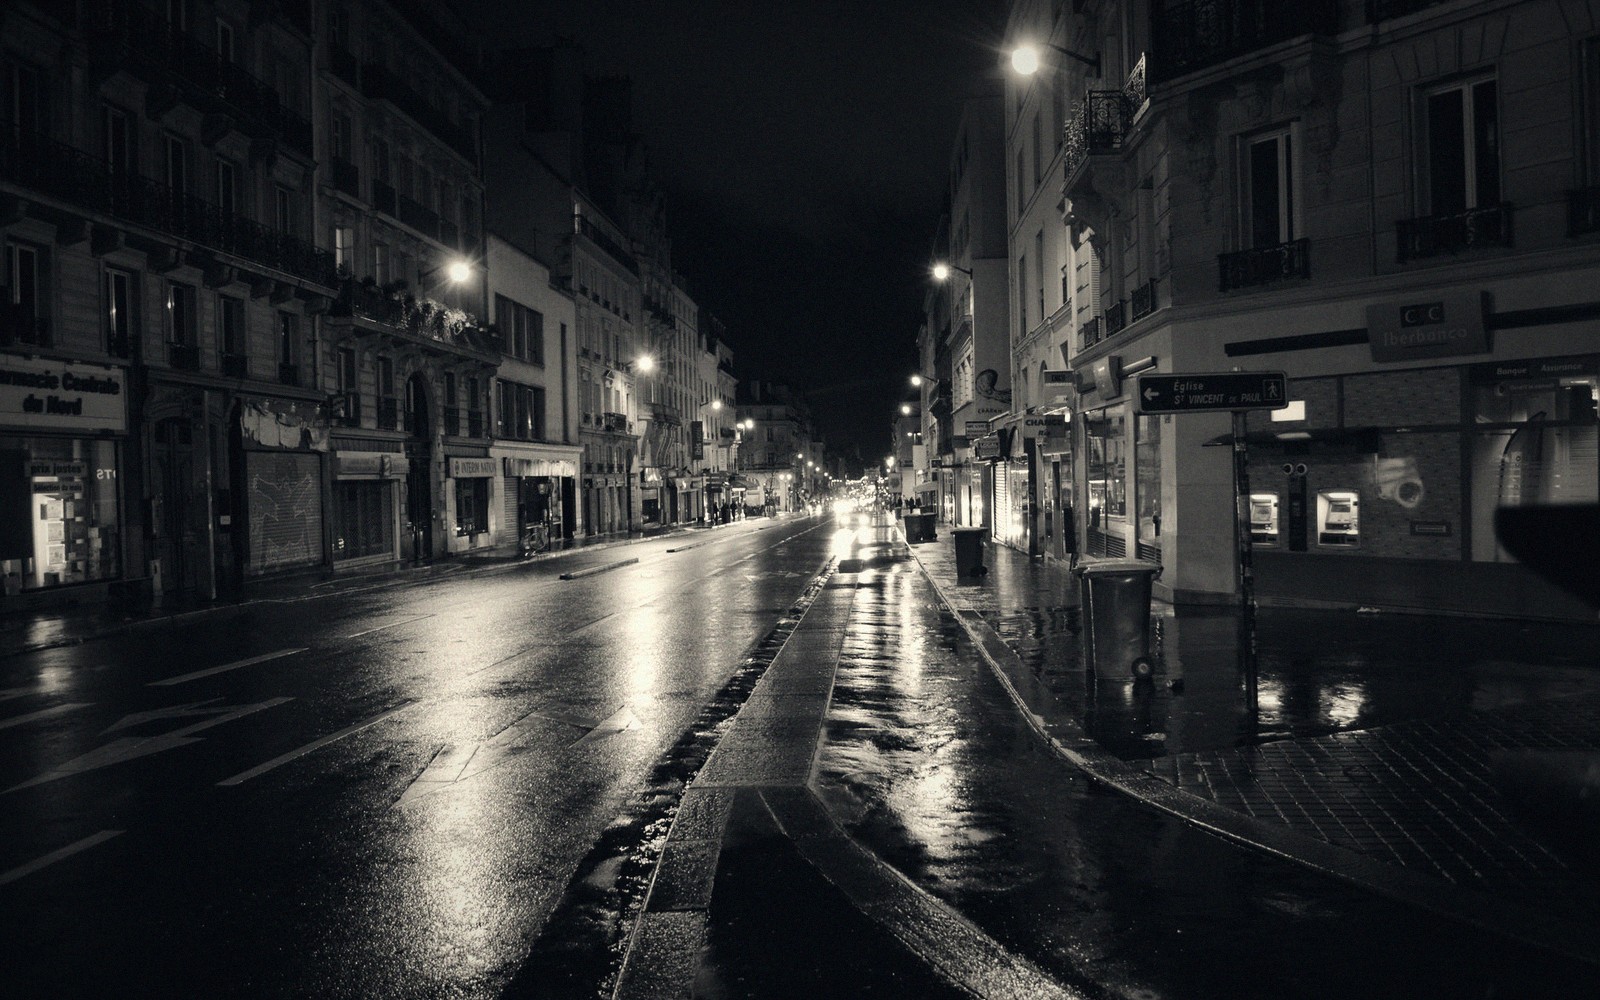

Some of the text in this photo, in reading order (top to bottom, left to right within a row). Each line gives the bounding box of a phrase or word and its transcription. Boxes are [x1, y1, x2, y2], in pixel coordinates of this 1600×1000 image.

[1383, 328, 1468, 347] Iberbanco
[1496, 363, 1583, 376] Banque Assurance
[62, 372, 119, 394] Centrale
[1173, 379, 1204, 393] Église
[23, 393, 82, 416] du Nord
[1188, 393, 1225, 405] VINCENT
[1240, 392, 1262, 403] PAUL
